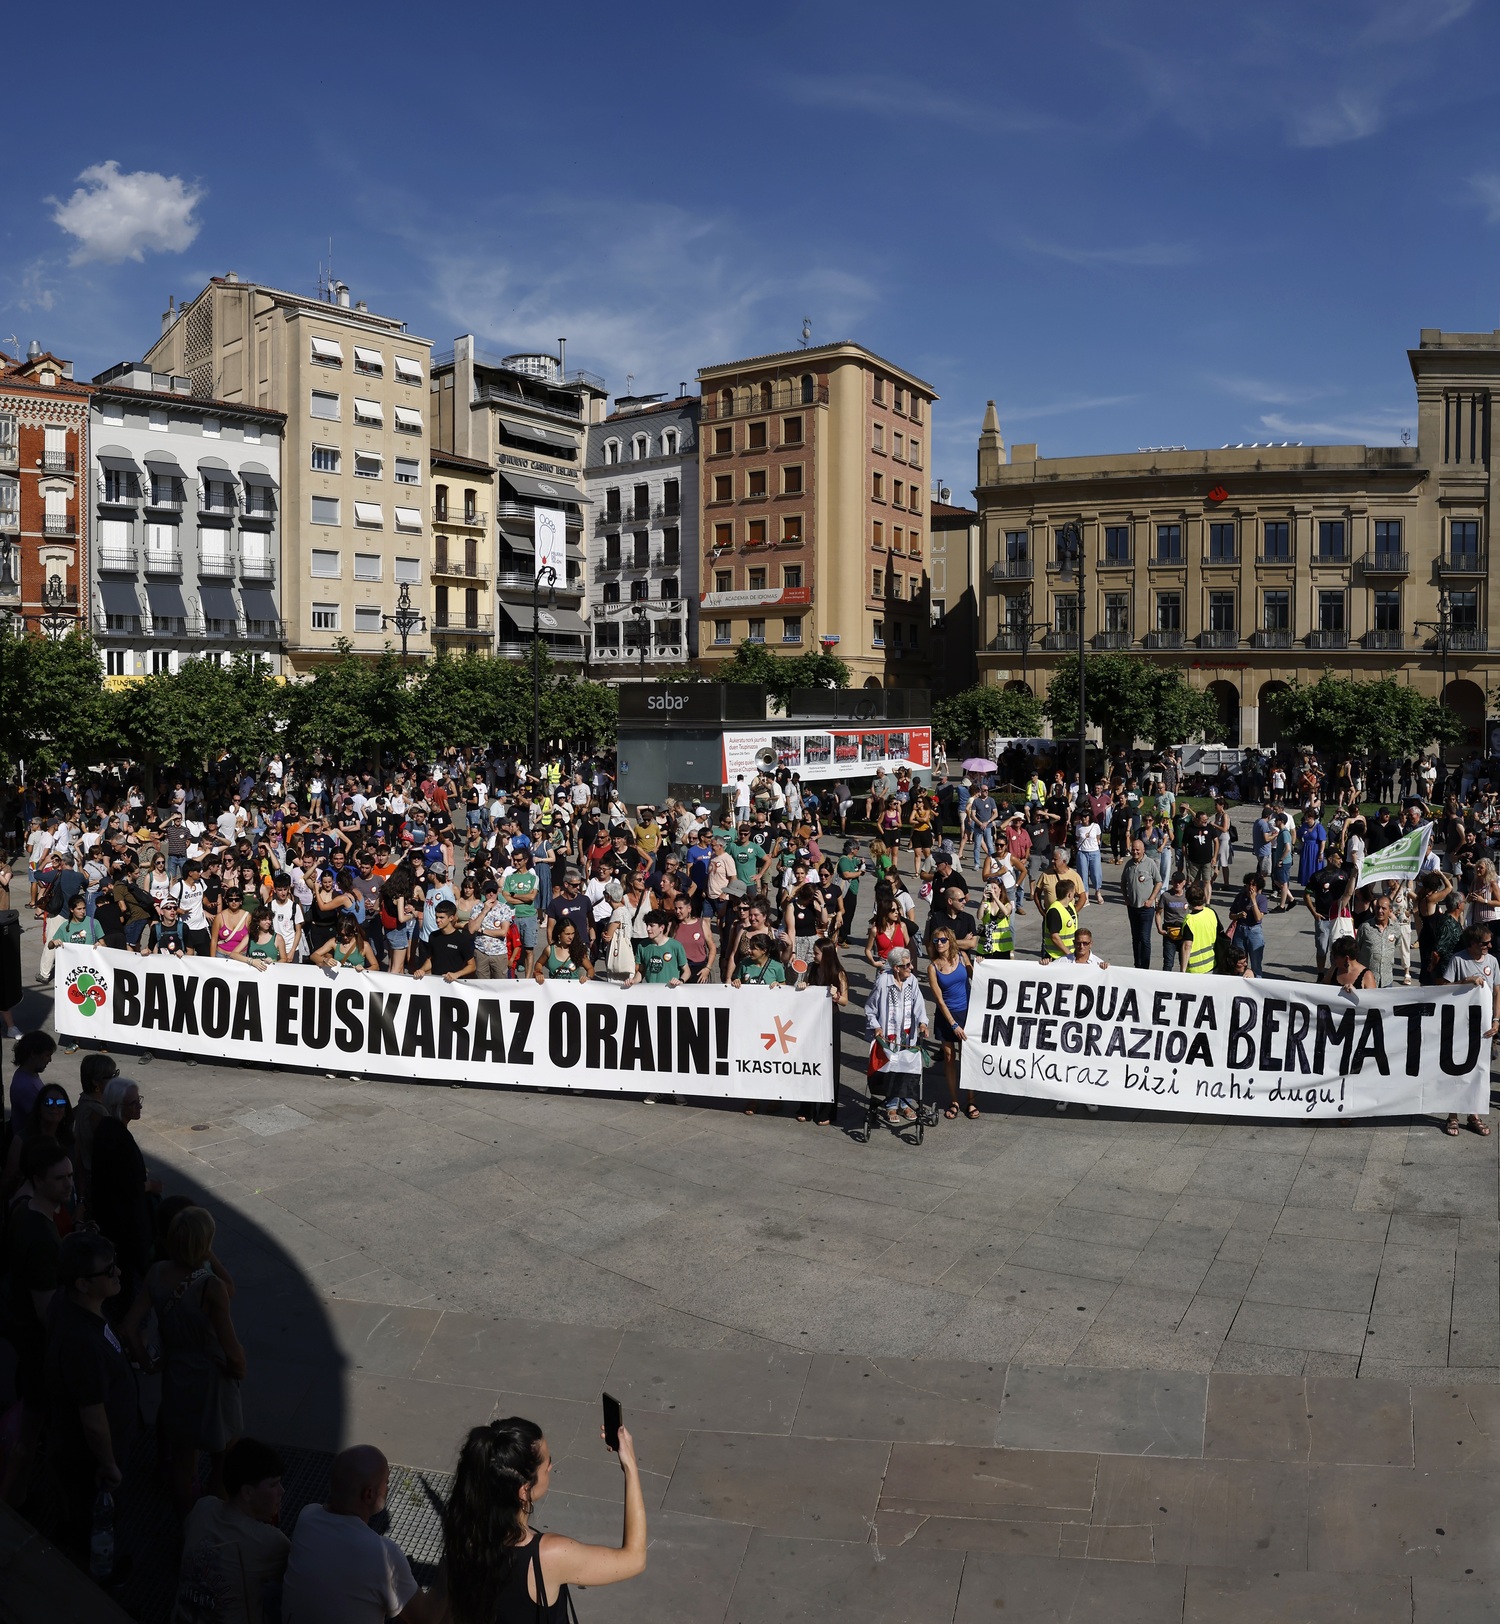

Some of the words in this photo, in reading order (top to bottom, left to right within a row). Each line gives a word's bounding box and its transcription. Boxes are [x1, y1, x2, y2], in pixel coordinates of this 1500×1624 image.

[507, 455, 528, 468] NUEVO
[531, 461, 554, 473] CASINO
[556, 466, 578, 478] ESLAVA
[113, 968, 263, 1042] BAXOA
[276, 984, 534, 1065] EUSKARAZ
[548, 1000, 731, 1075] ORAIN!
[986, 979, 1007, 1010] D
[1016, 981, 1140, 1022] EREDUA
[1152, 991, 1217, 1030] ETA
[982, 1014, 1213, 1067] INTEGRAZIOA
[1227, 996, 1483, 1077] BERMATU
[982, 1053, 1109, 1087] euskaraz
[1125, 1064, 1180, 1096] bizi
[1196, 1073, 1254, 1100] nahi
[1269, 1078, 1346, 1112] dugu!
